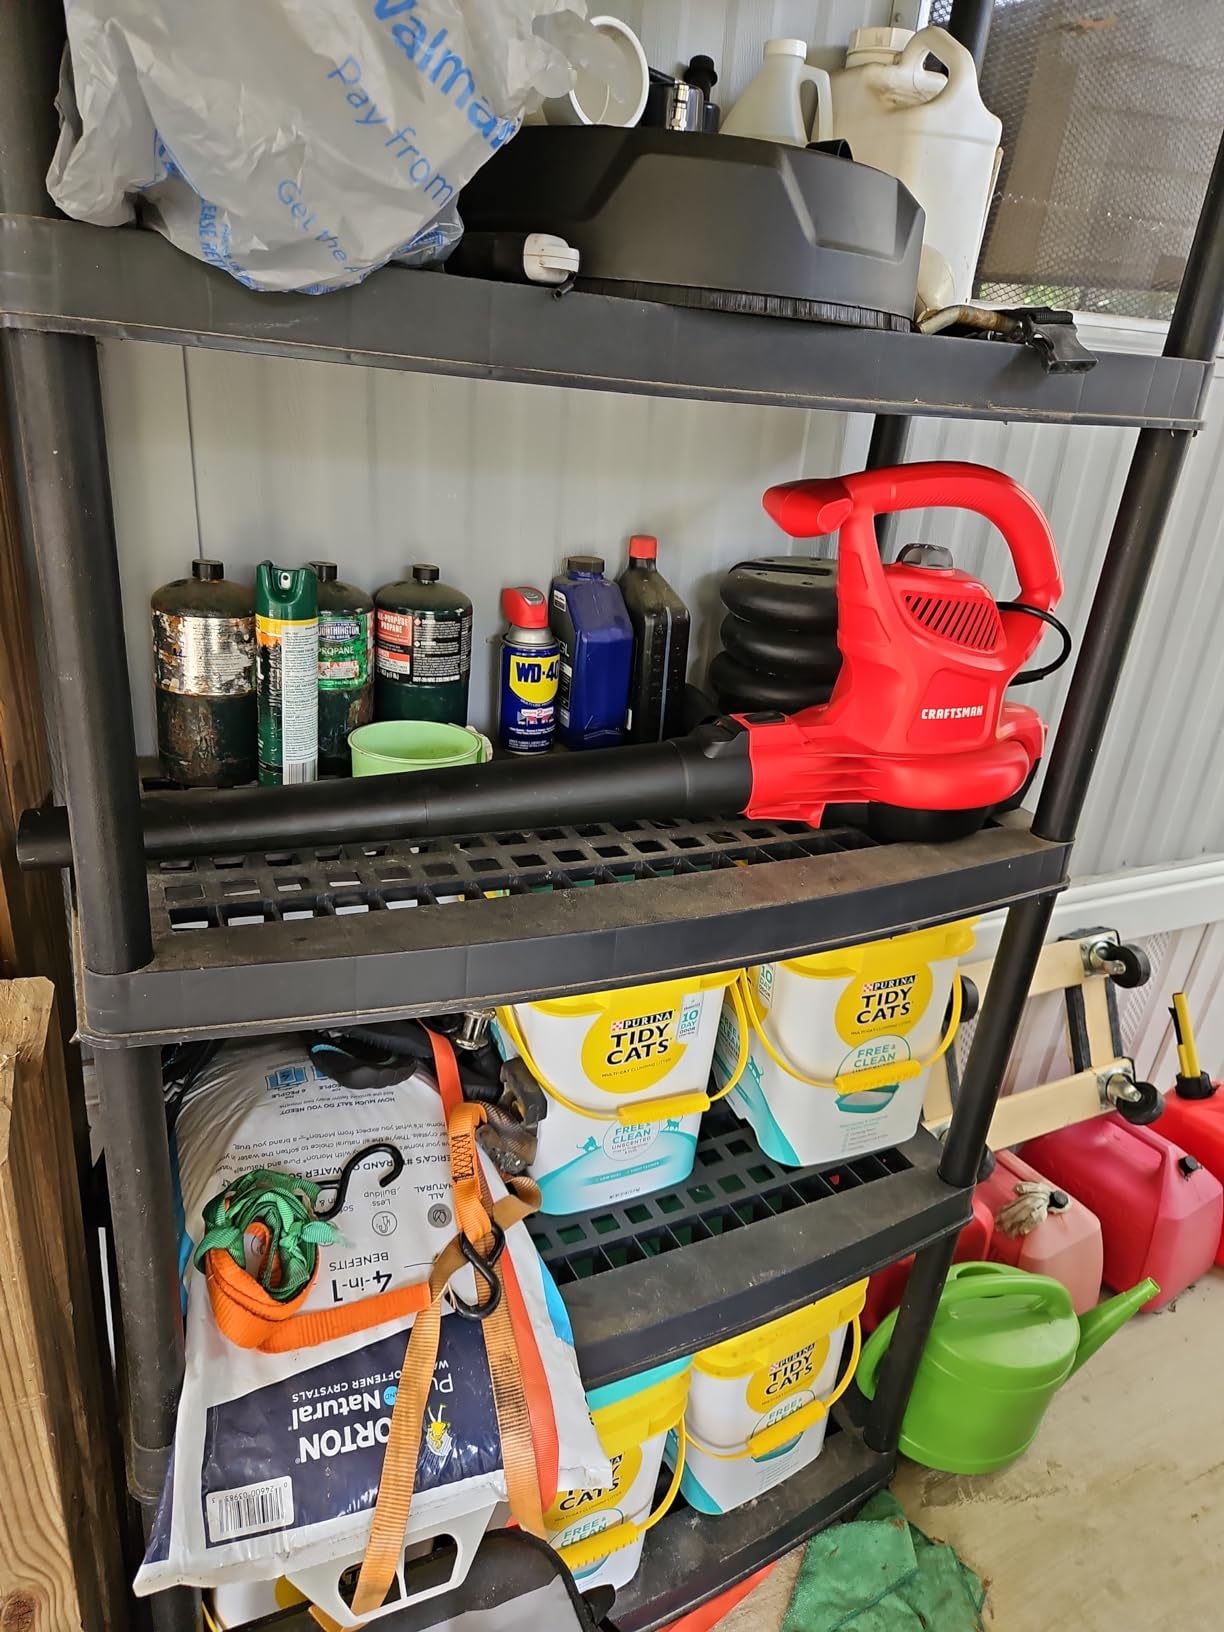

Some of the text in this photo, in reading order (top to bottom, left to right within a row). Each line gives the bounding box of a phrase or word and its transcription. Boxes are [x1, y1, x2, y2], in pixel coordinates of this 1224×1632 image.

[373, 0, 516, 149] almar
[327, 54, 388, 126] Pay
[384, 126, 454, 209] from
[277, 178, 317, 231] Get
[377, 611, 409, 626] LL-PURPOSE
[515, 660, 559, 684] WD-40
[921, 705, 984, 720] CRAFTSMAN
[761, 965, 773, 985] 10
[874, 976, 915, 990] PURINA
[861, 986, 912, 1009] TIDY
[682, 1009, 699, 1023] 10
[856, 1001, 910, 1024] CATS
[624, 1011, 672, 1029] PURINA
[680, 1020, 696, 1031] DAY
[610, 1022, 670, 1048] TIDY
[606, 1038, 669, 1065] CATS
[857, 1044, 889, 1058] FREE
[853, 1052, 896, 1068] CLEAN
[601, 1069, 631, 1079] MULTI-CAT
[271, 1090, 300, 1099] PEOPLE
[354, 1098, 376, 1106] MUCH
[279, 1107, 305, 1116] NEED?
[356, 1126, 380, 1135] expect
[381, 1124, 394, 1132] you
[395, 1123, 412, 1131] what
[615, 1124, 645, 1136] FREE
[337, 1130, 355, 1138] from
[386, 1134, 409, 1142] They're
[612, 1128, 651, 1144] CLEAN
[252, 1140, 267, 1149] you
[268, 1138, 291, 1147] brand
[310, 1142, 334, 1150] choice
[335, 1139, 361, 1148] natural
[399, 1142, 425, 1151] home's
[425, 1139, 441, 1149] your
[611, 1136, 652, 1151] UNSCENTED
[237, 1153, 261, 1161] water
[275, 1146, 300, 1156] soften
[334, 1150, 351, 1159] with
[267, 1161, 282, 1169] and
[283, 1157, 301, 1166] Pure
[362, 1159, 394, 1170] RAND
[415, 1154, 450, 1165] ERICA'S
[304, 1166, 343, 1179] WATER
[363, 1189, 397, 1200] Buildup
[428, 1191, 445, 1200] ALL
[371, 1198, 391, 1208] Less
[328, 1252, 390, 1272] BENEFITS
[330, 1270, 393, 1303] 4-in-1
[769, 1351, 813, 1382] TIDY
[431, 1372, 454, 1394] Pu
[765, 1362, 813, 1395] CATS
[291, 1382, 348, 1402] CRYSTALS
[768, 1399, 799, 1421] FREE
[250, 1485, 274, 1497] 24600
[559, 1477, 620, 1511] CATS
[560, 1522, 608, 1548] CLEAN
[563, 1518, 600, 1540] FREE
